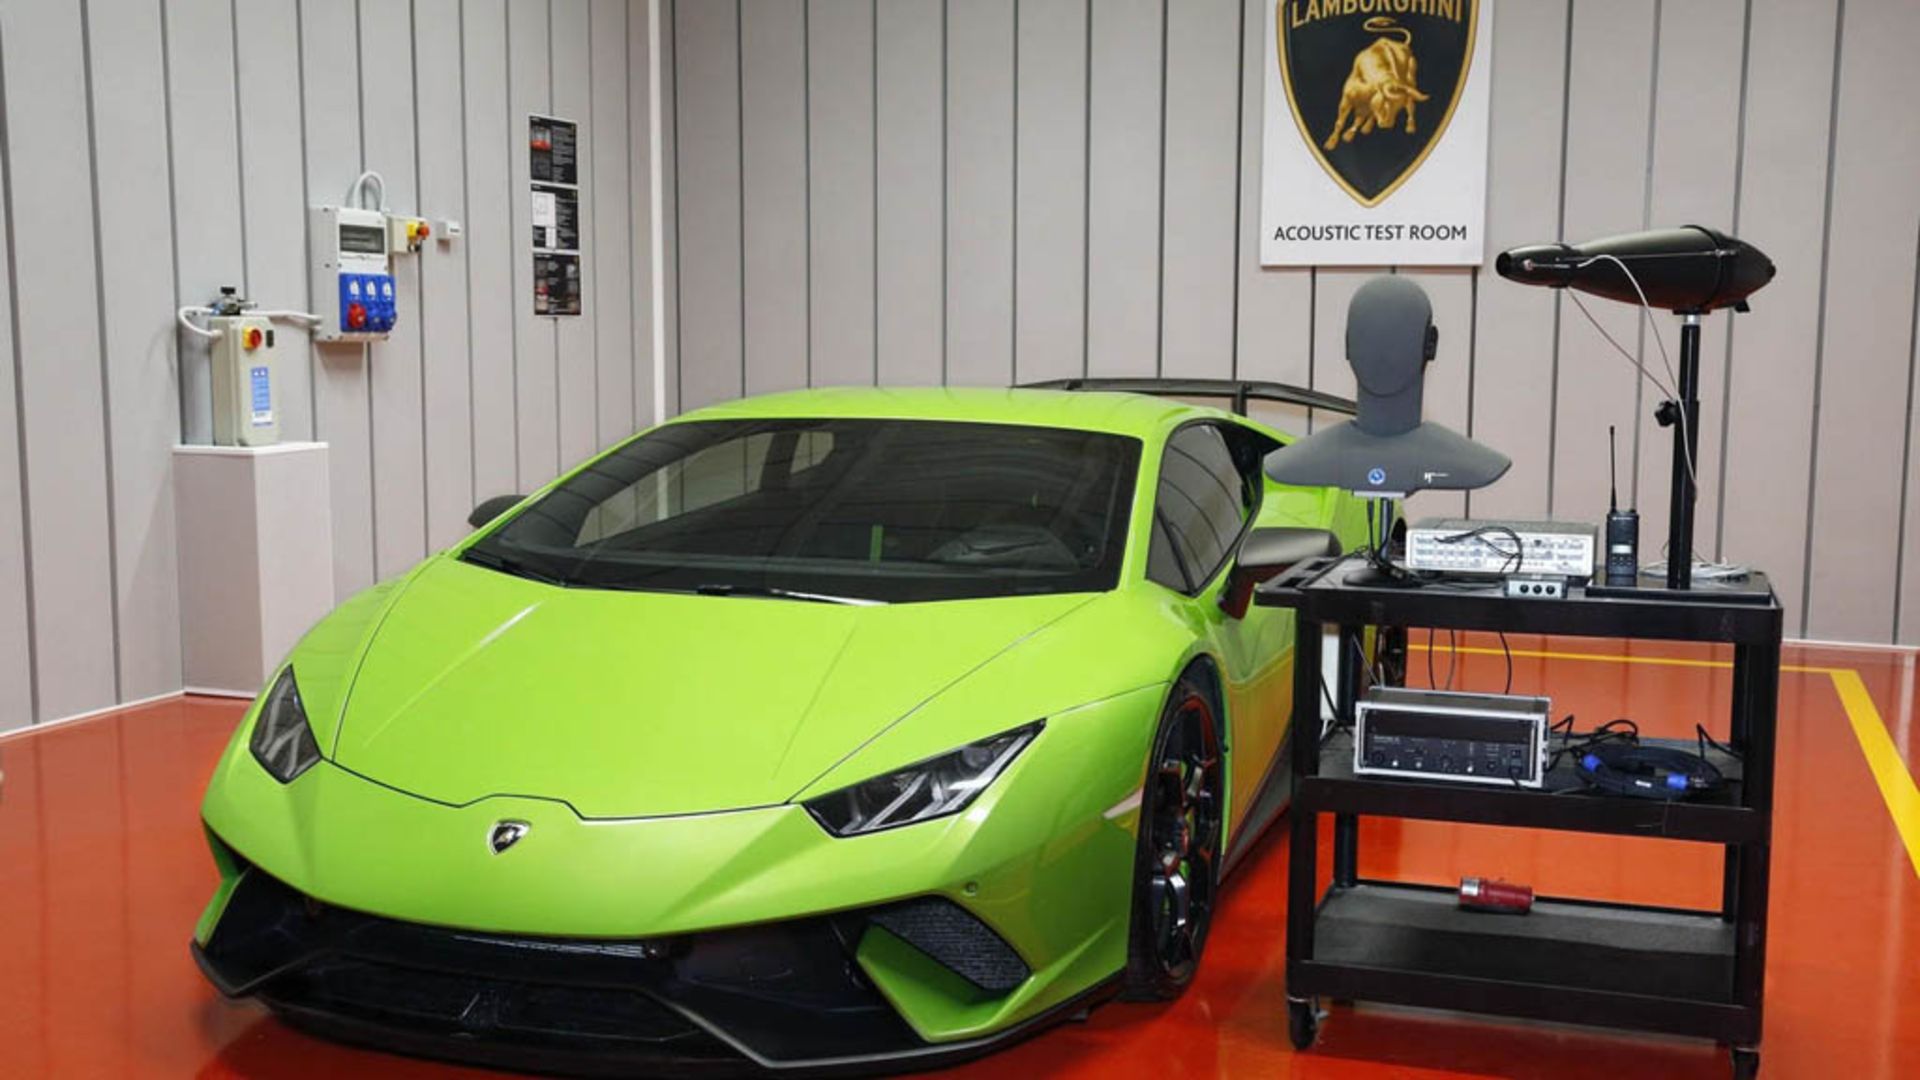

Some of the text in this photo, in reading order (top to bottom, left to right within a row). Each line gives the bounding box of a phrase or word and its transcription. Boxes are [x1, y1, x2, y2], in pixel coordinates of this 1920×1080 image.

[1274, 225, 1467, 241] ACOUSTIC TEST ROOM
